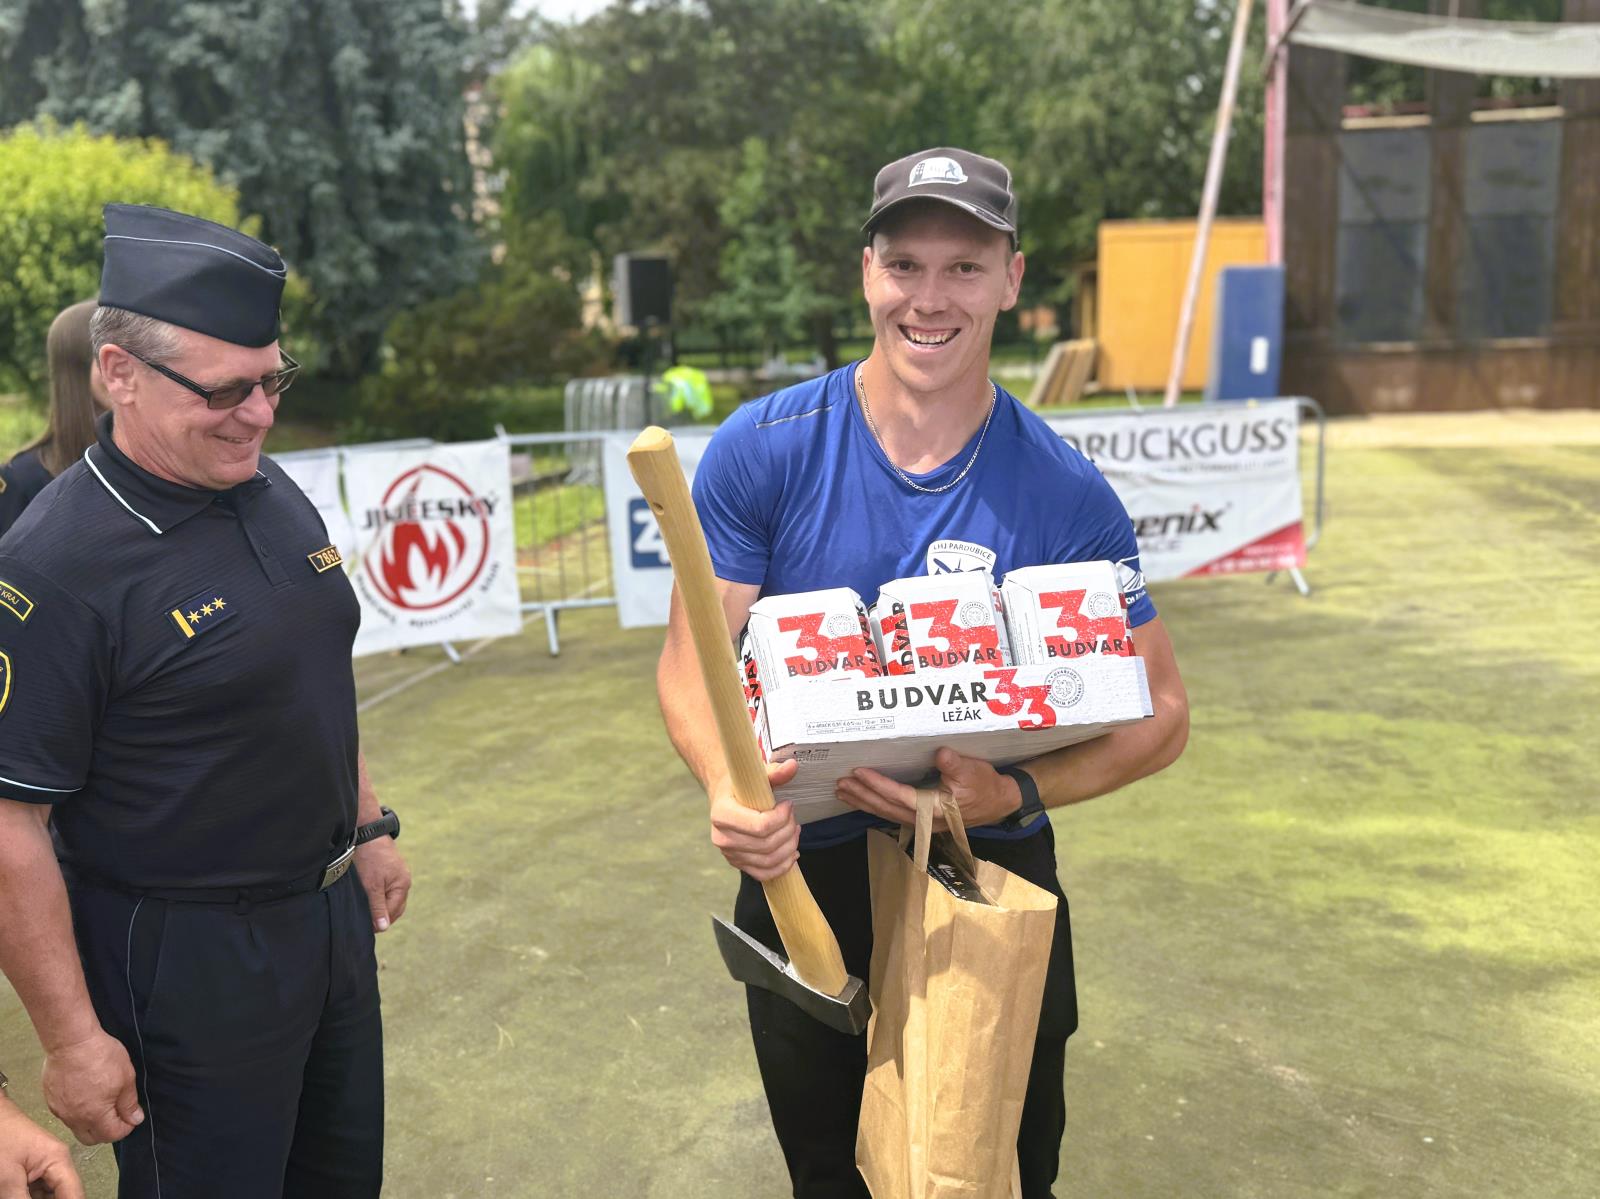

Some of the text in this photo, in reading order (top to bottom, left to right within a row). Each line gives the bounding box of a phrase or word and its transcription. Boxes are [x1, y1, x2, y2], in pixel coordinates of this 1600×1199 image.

[1133, 504, 1224, 537] enix
[949, 542, 993, 560] PARDUBICE
[1, 589, 20, 605] KRAJ
[1048, 638, 1124, 657] BUDVAR
[787, 655, 866, 677] BUDVAR
[919, 648, 997, 668] BUDVAR
[857, 682, 986, 711] BUDVAR
[984, 669, 1057, 731] 33
[943, 706, 981, 722] LEŽÁK
